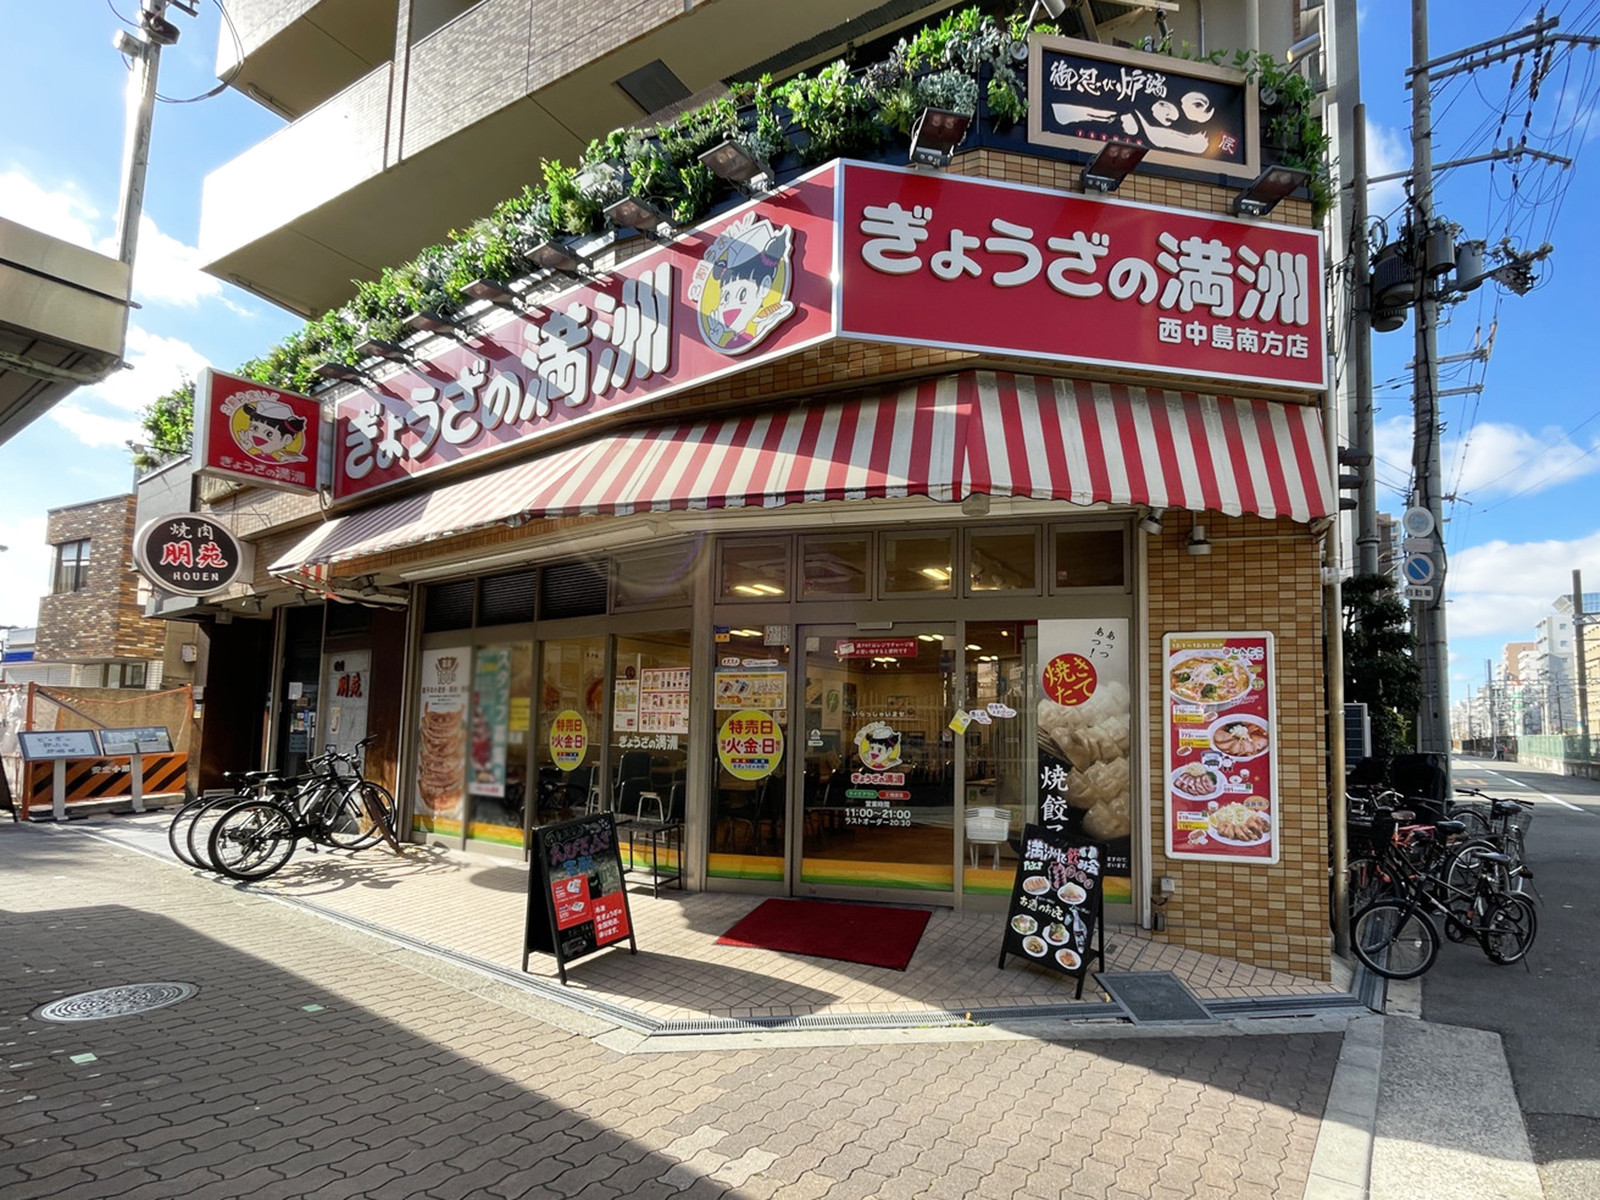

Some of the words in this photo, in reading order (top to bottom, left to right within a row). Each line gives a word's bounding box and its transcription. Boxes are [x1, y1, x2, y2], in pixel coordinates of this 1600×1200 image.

[860, 202, 1309, 326] ぎょうざの満洲
[1158, 316, 1309, 359] 西中島南方店
[345, 262, 672, 479] ぎょうざの満洲
[220, 455, 306, 484] ぎょうざの満洲
[169, 522, 214, 540] 焼肉
[160, 540, 229, 568] 朋苑
[173, 571, 220, 582] HOUEN
[729, 719, 774, 735] 特売日
[618, 734, 679, 750] ぎょうざの満洲
[851, 773, 905, 786] ぎょうざの満洲
